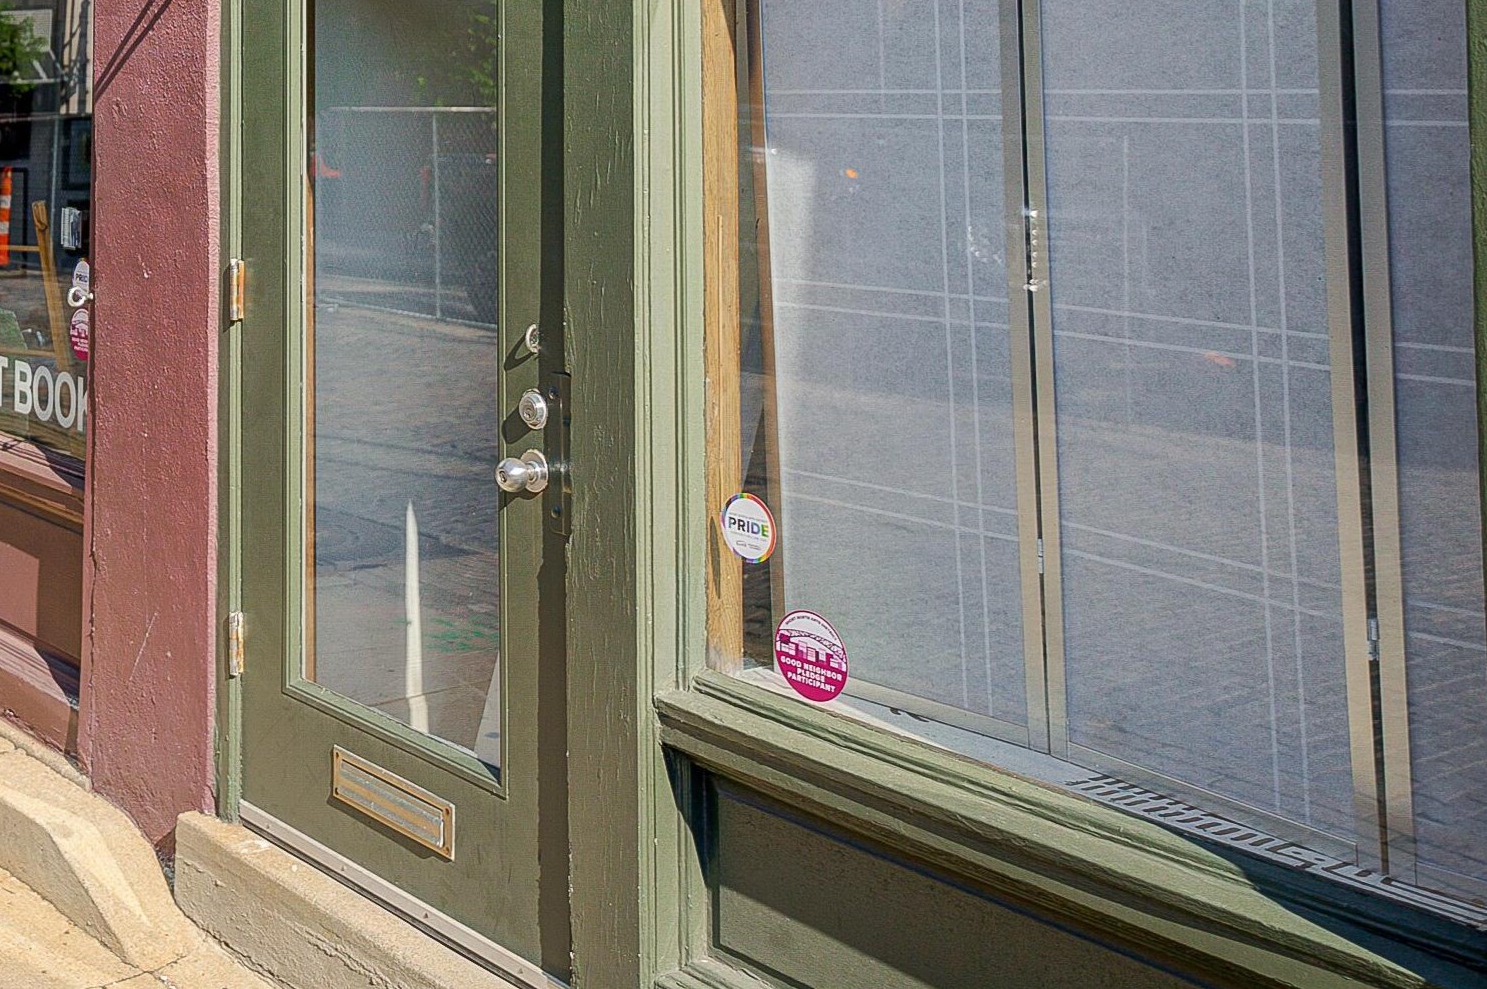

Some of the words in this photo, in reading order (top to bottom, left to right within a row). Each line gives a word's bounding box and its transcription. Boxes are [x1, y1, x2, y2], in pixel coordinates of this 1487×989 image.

[728, 516, 769, 538] PRIDE
[780, 655, 802, 668] GOOD
[803, 662, 843, 682] NEIGHBOR
[796, 667, 826, 683] PLEDGE
[787, 671, 836, 693] PARTICIPANT
